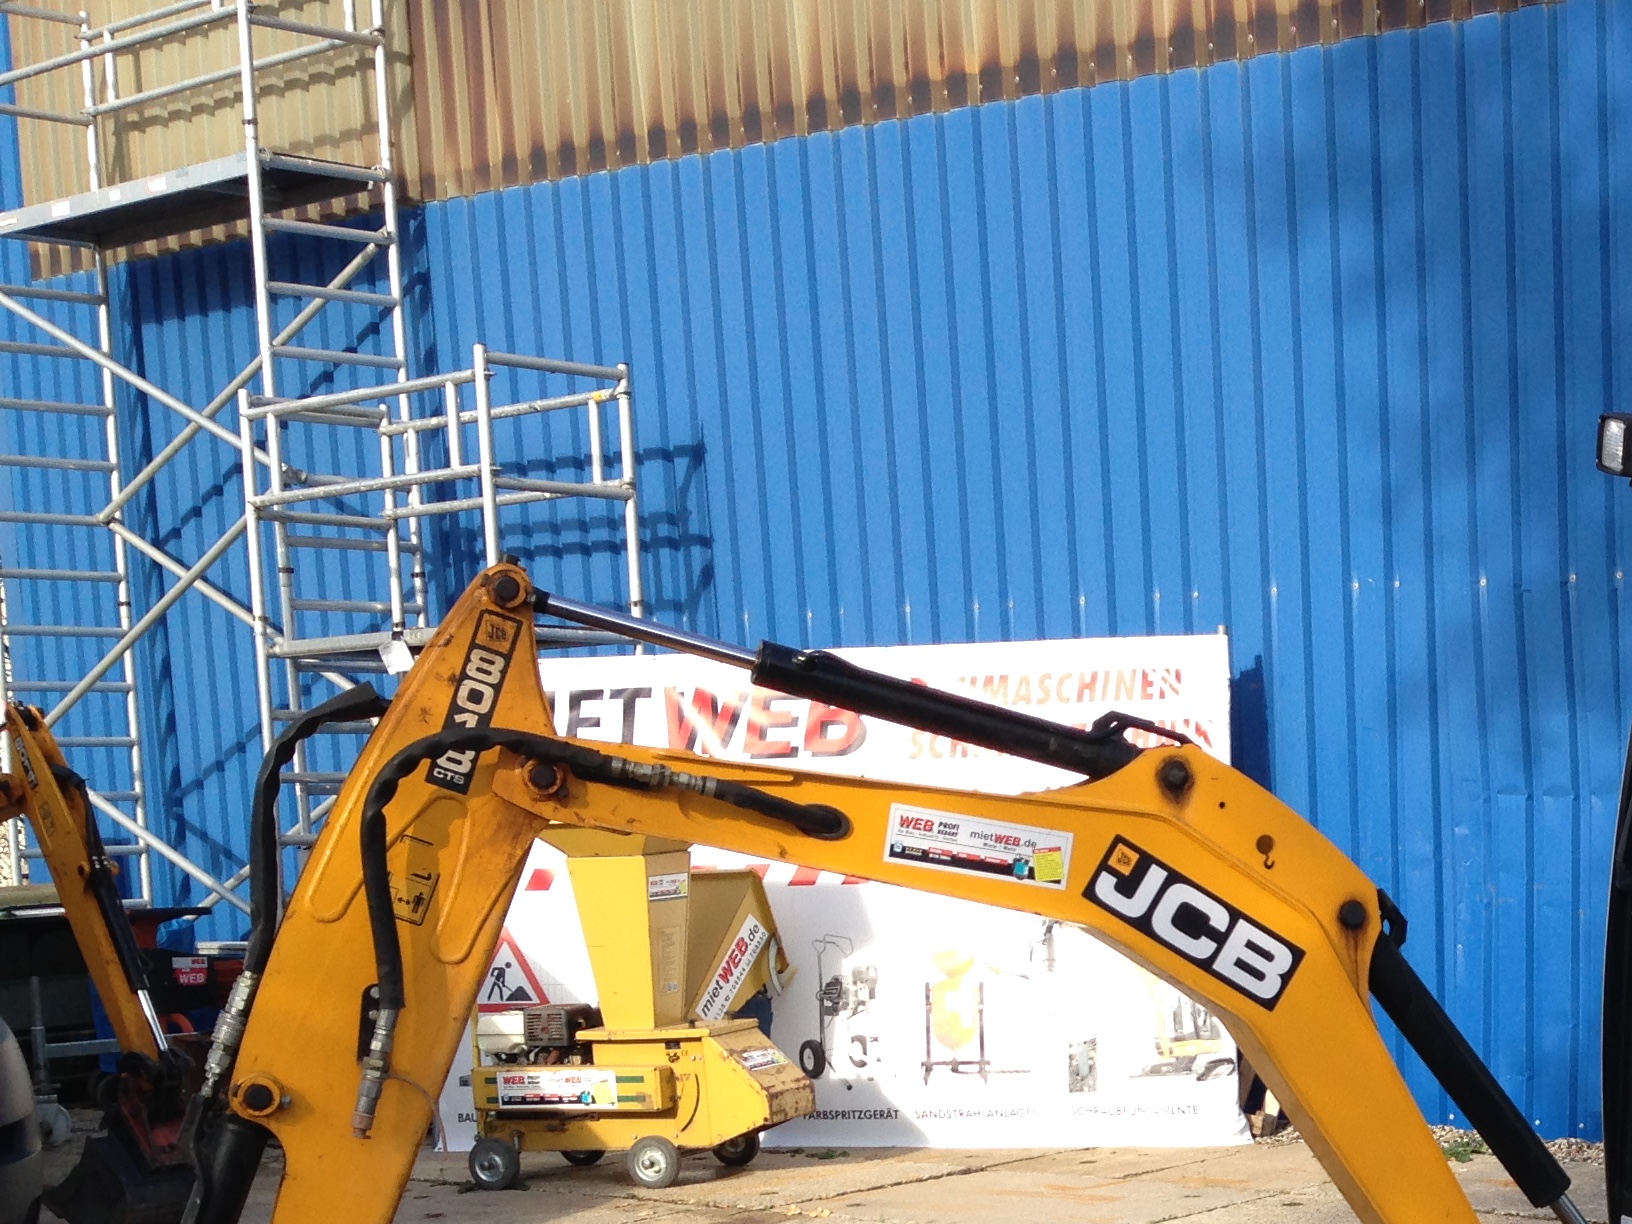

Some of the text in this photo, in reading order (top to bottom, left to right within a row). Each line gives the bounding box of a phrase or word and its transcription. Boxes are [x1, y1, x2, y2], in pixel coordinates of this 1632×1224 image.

[911, 668, 1182, 705] MASCHINEN
[433, 767, 465, 785] CTS
[899, 815, 935, 833] WEB
[1094, 863, 1293, 999] JCB
